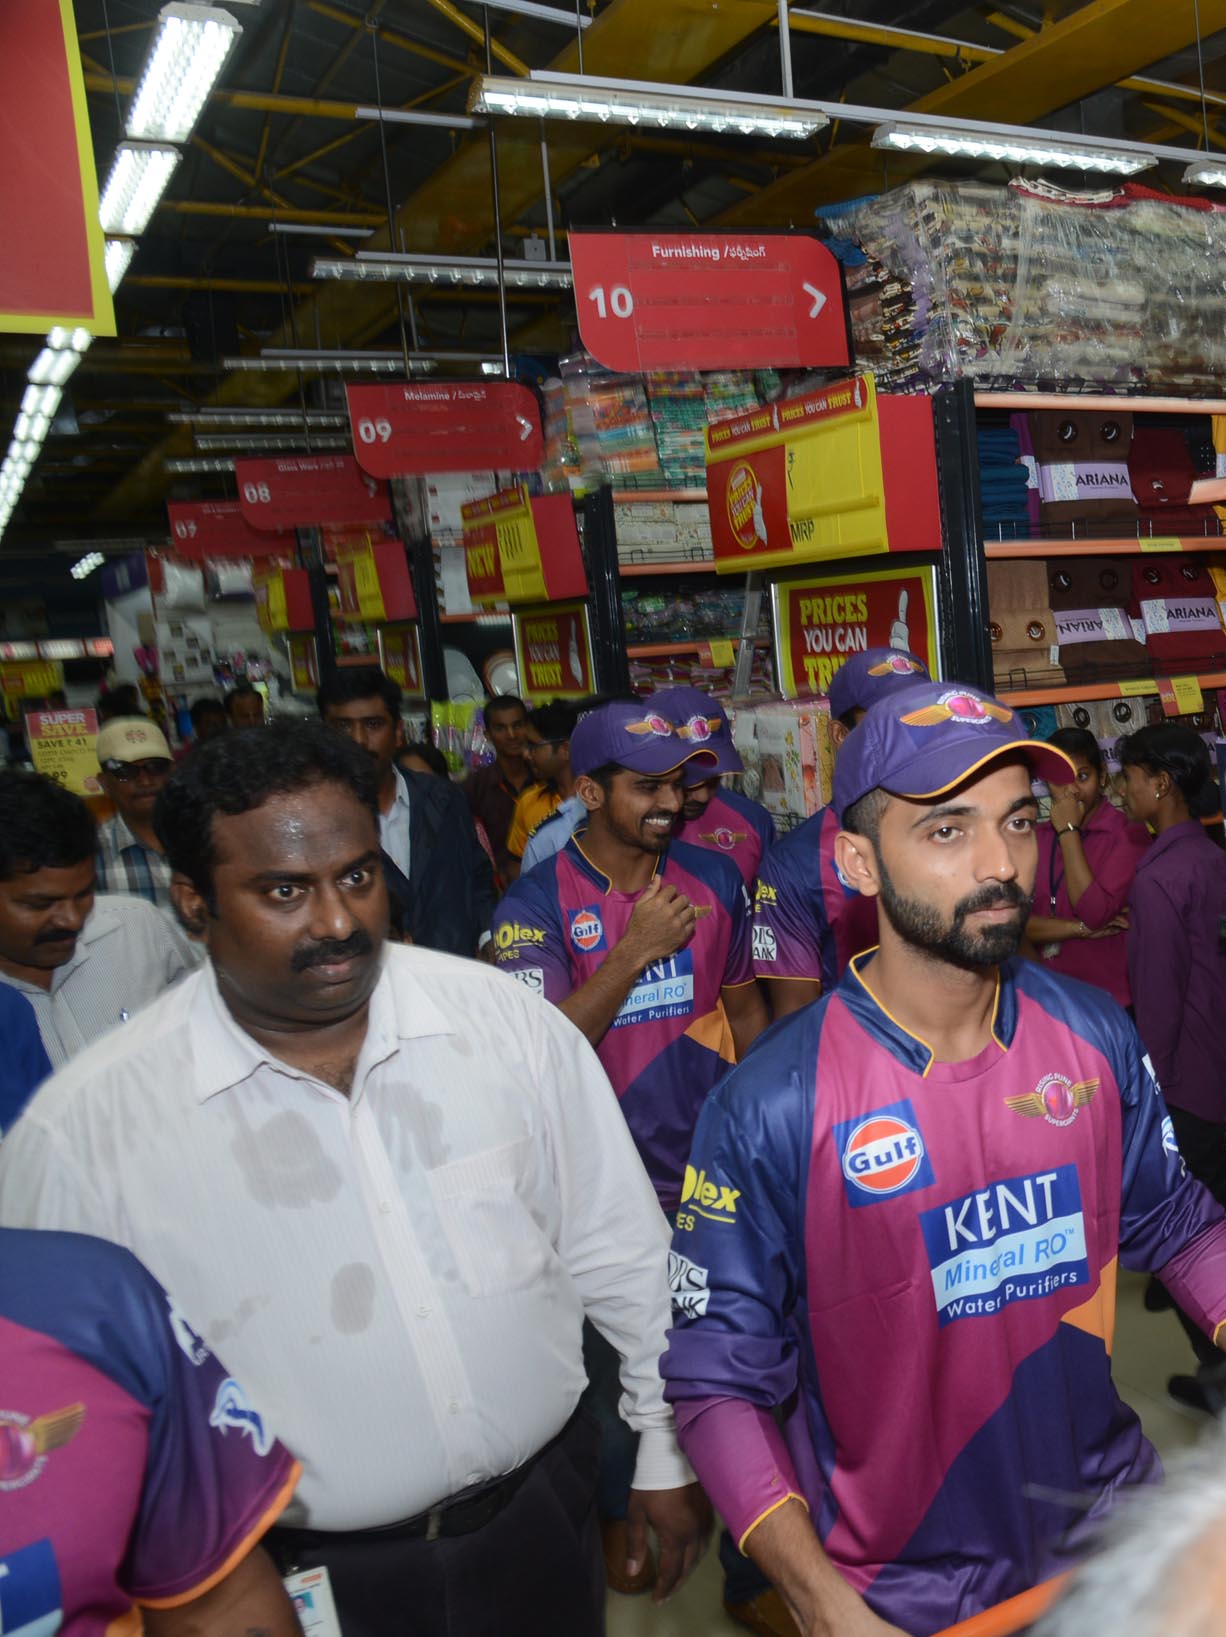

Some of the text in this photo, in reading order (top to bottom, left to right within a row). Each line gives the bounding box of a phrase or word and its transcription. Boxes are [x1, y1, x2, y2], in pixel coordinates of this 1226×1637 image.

[652, 244, 720, 261] Furnishing
[588, 286, 634, 319] 10
[404, 390, 450, 401] Melamine
[828, 392, 852, 410] TRUST
[359, 418, 392, 443] 09
[1076, 473, 1129, 487] ARIANA
[790, 519, 815, 544] MRP
[800, 594, 868, 625] PRICES
[1166, 606, 1216, 620] ARIANA
[804, 626, 868, 653] YOU CAN
[529, 662, 562, 687] TRUST
[40, 712, 86, 726] SUPER
[40, 723, 88, 737] SAVE
[37, 739, 63, 750] SAVE
[614, 1005, 690, 1029] Water Purifiers
[848, 1137, 920, 1175] Gulf
[945, 1172, 1058, 1251] KENT
[945, 1243, 1025, 1292] Mineral
[947, 1270, 1078, 1319] Water Purifiers
